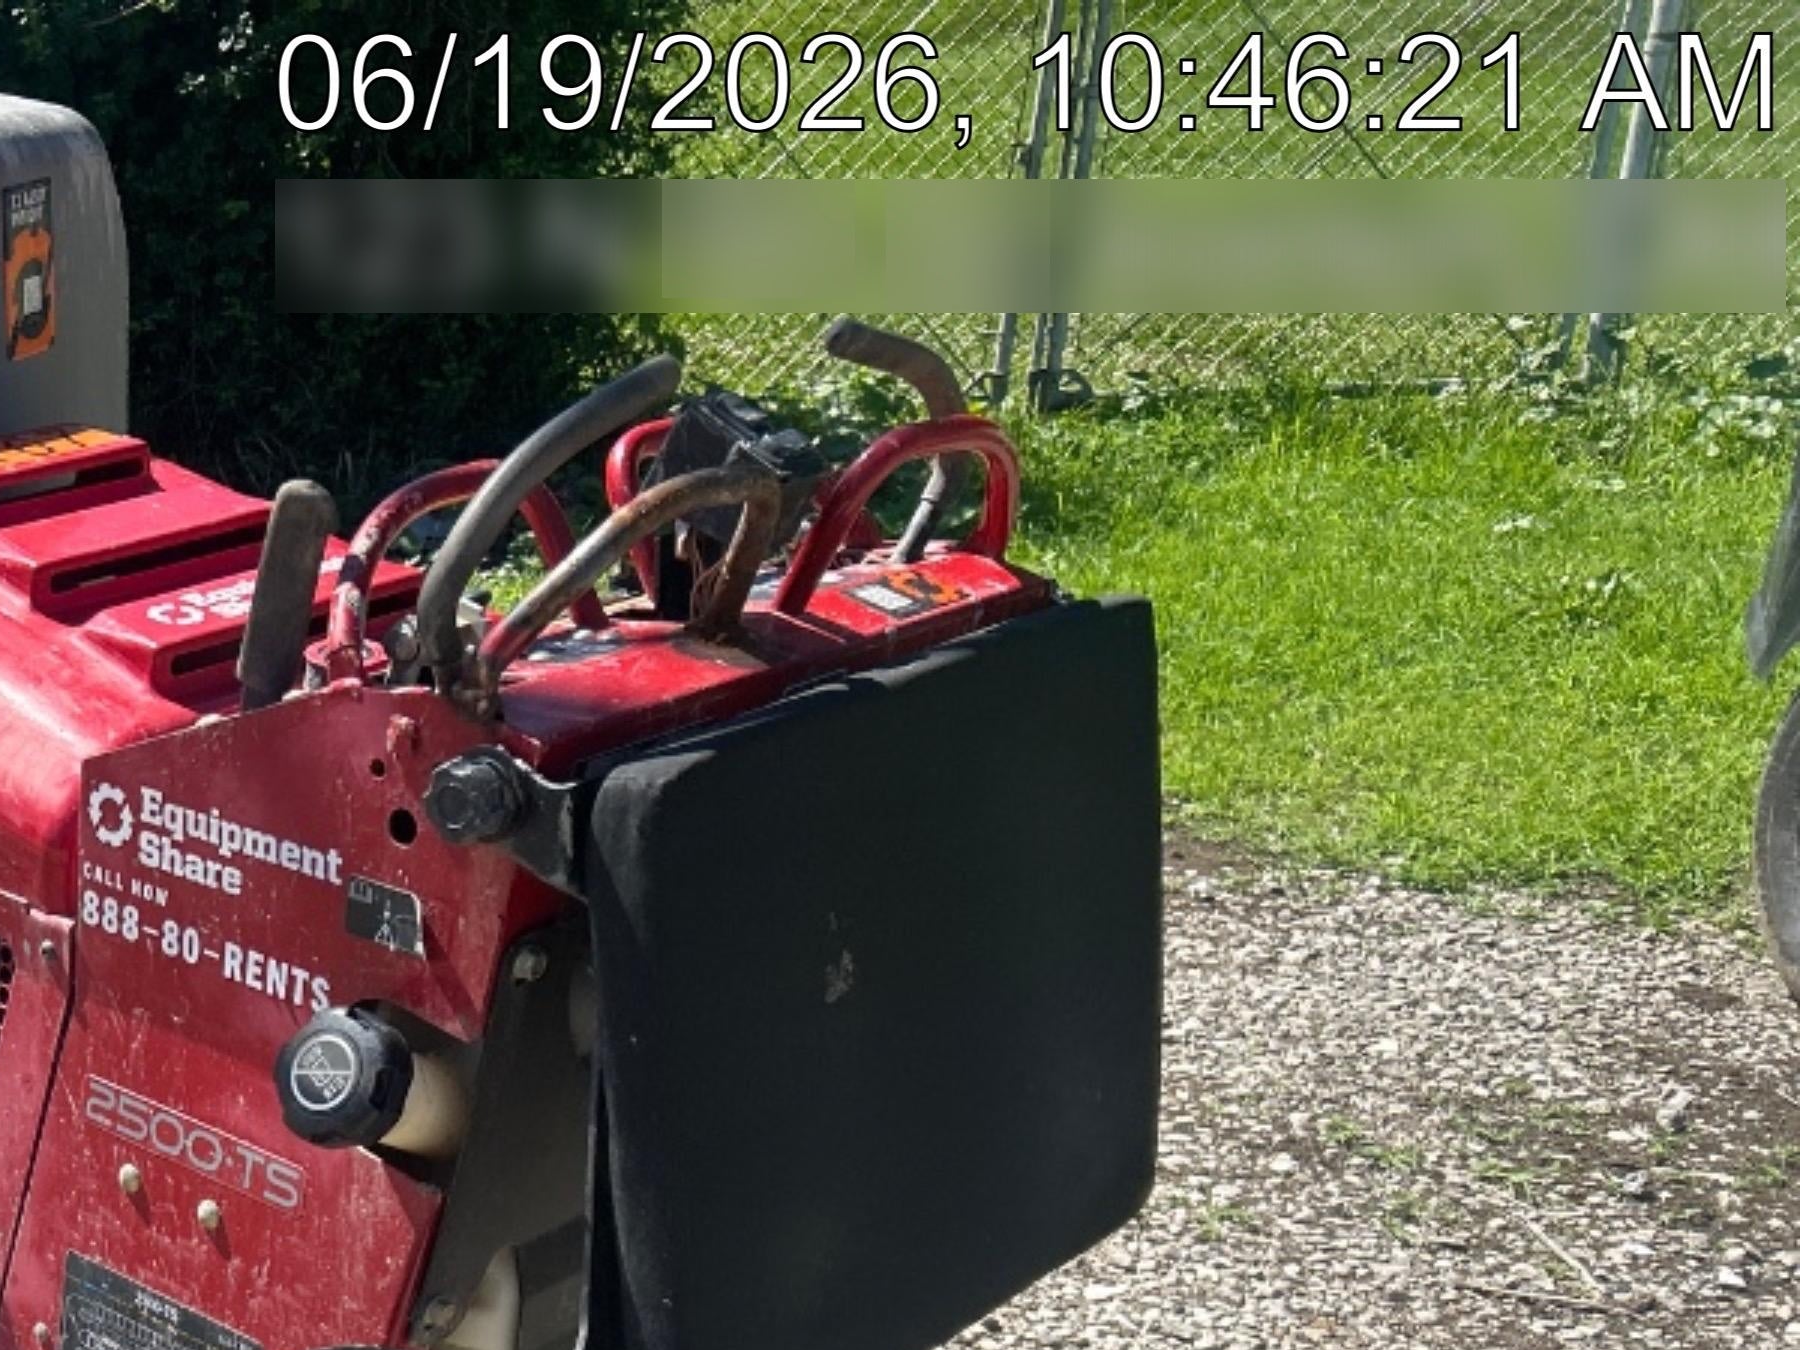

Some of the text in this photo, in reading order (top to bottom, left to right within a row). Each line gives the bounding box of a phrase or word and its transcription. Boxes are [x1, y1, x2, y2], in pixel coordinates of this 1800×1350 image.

[82, 860, 125, 892] CALL
[137, 829, 243, 896] Share
[139, 785, 344, 885] Equipment
[81, 889, 332, 1013] 888-80-RENTS
